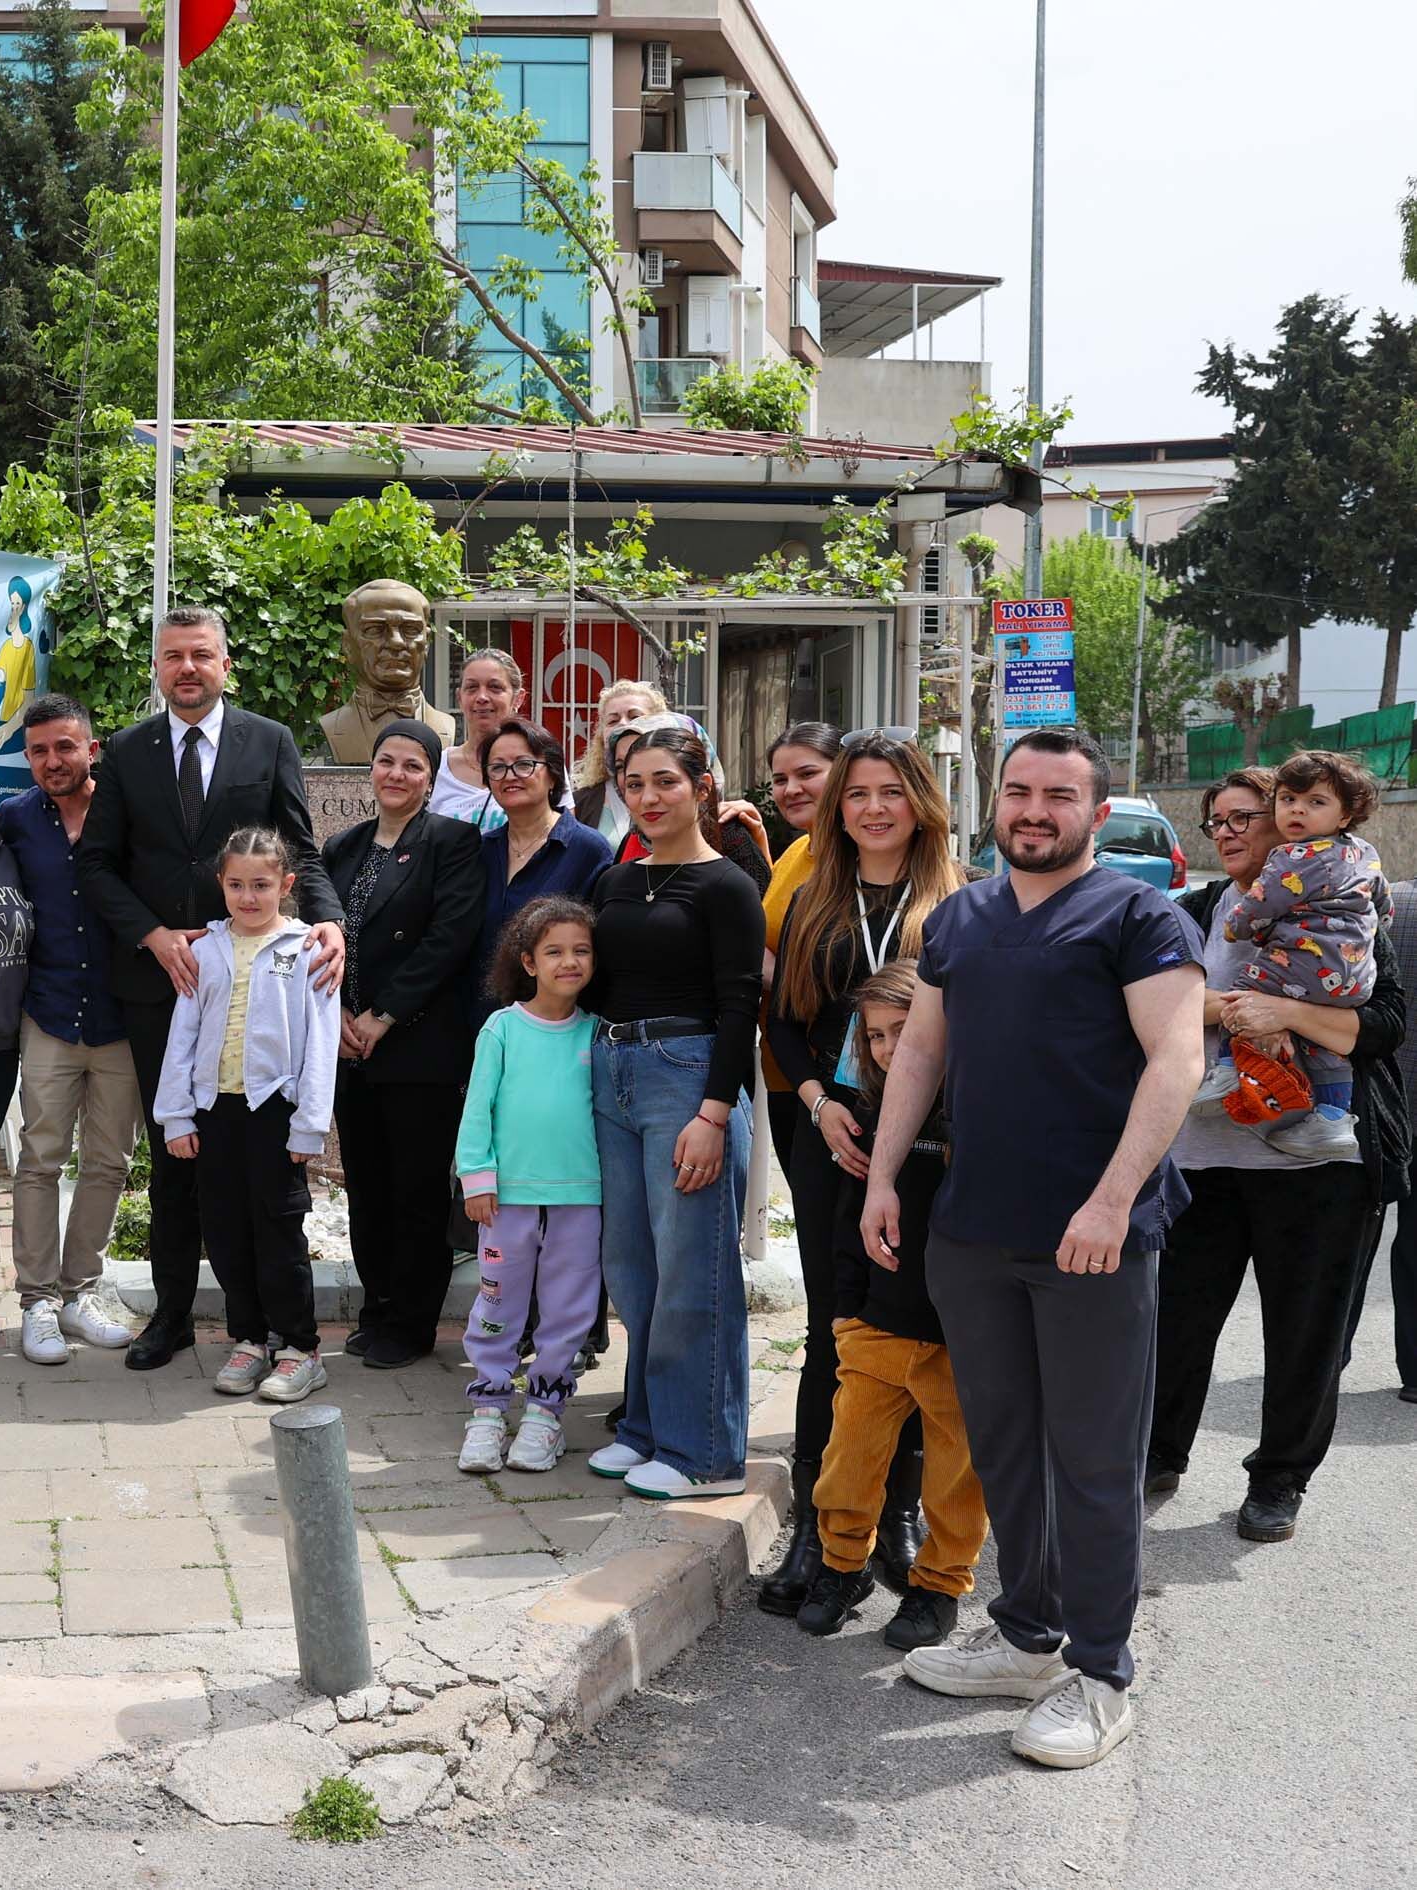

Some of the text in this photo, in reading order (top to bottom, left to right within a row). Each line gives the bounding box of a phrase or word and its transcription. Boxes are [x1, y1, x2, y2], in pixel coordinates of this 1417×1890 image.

[1001, 602, 1067, 619] TOKER
[997, 620, 1070, 630] HALI YIKAMA
